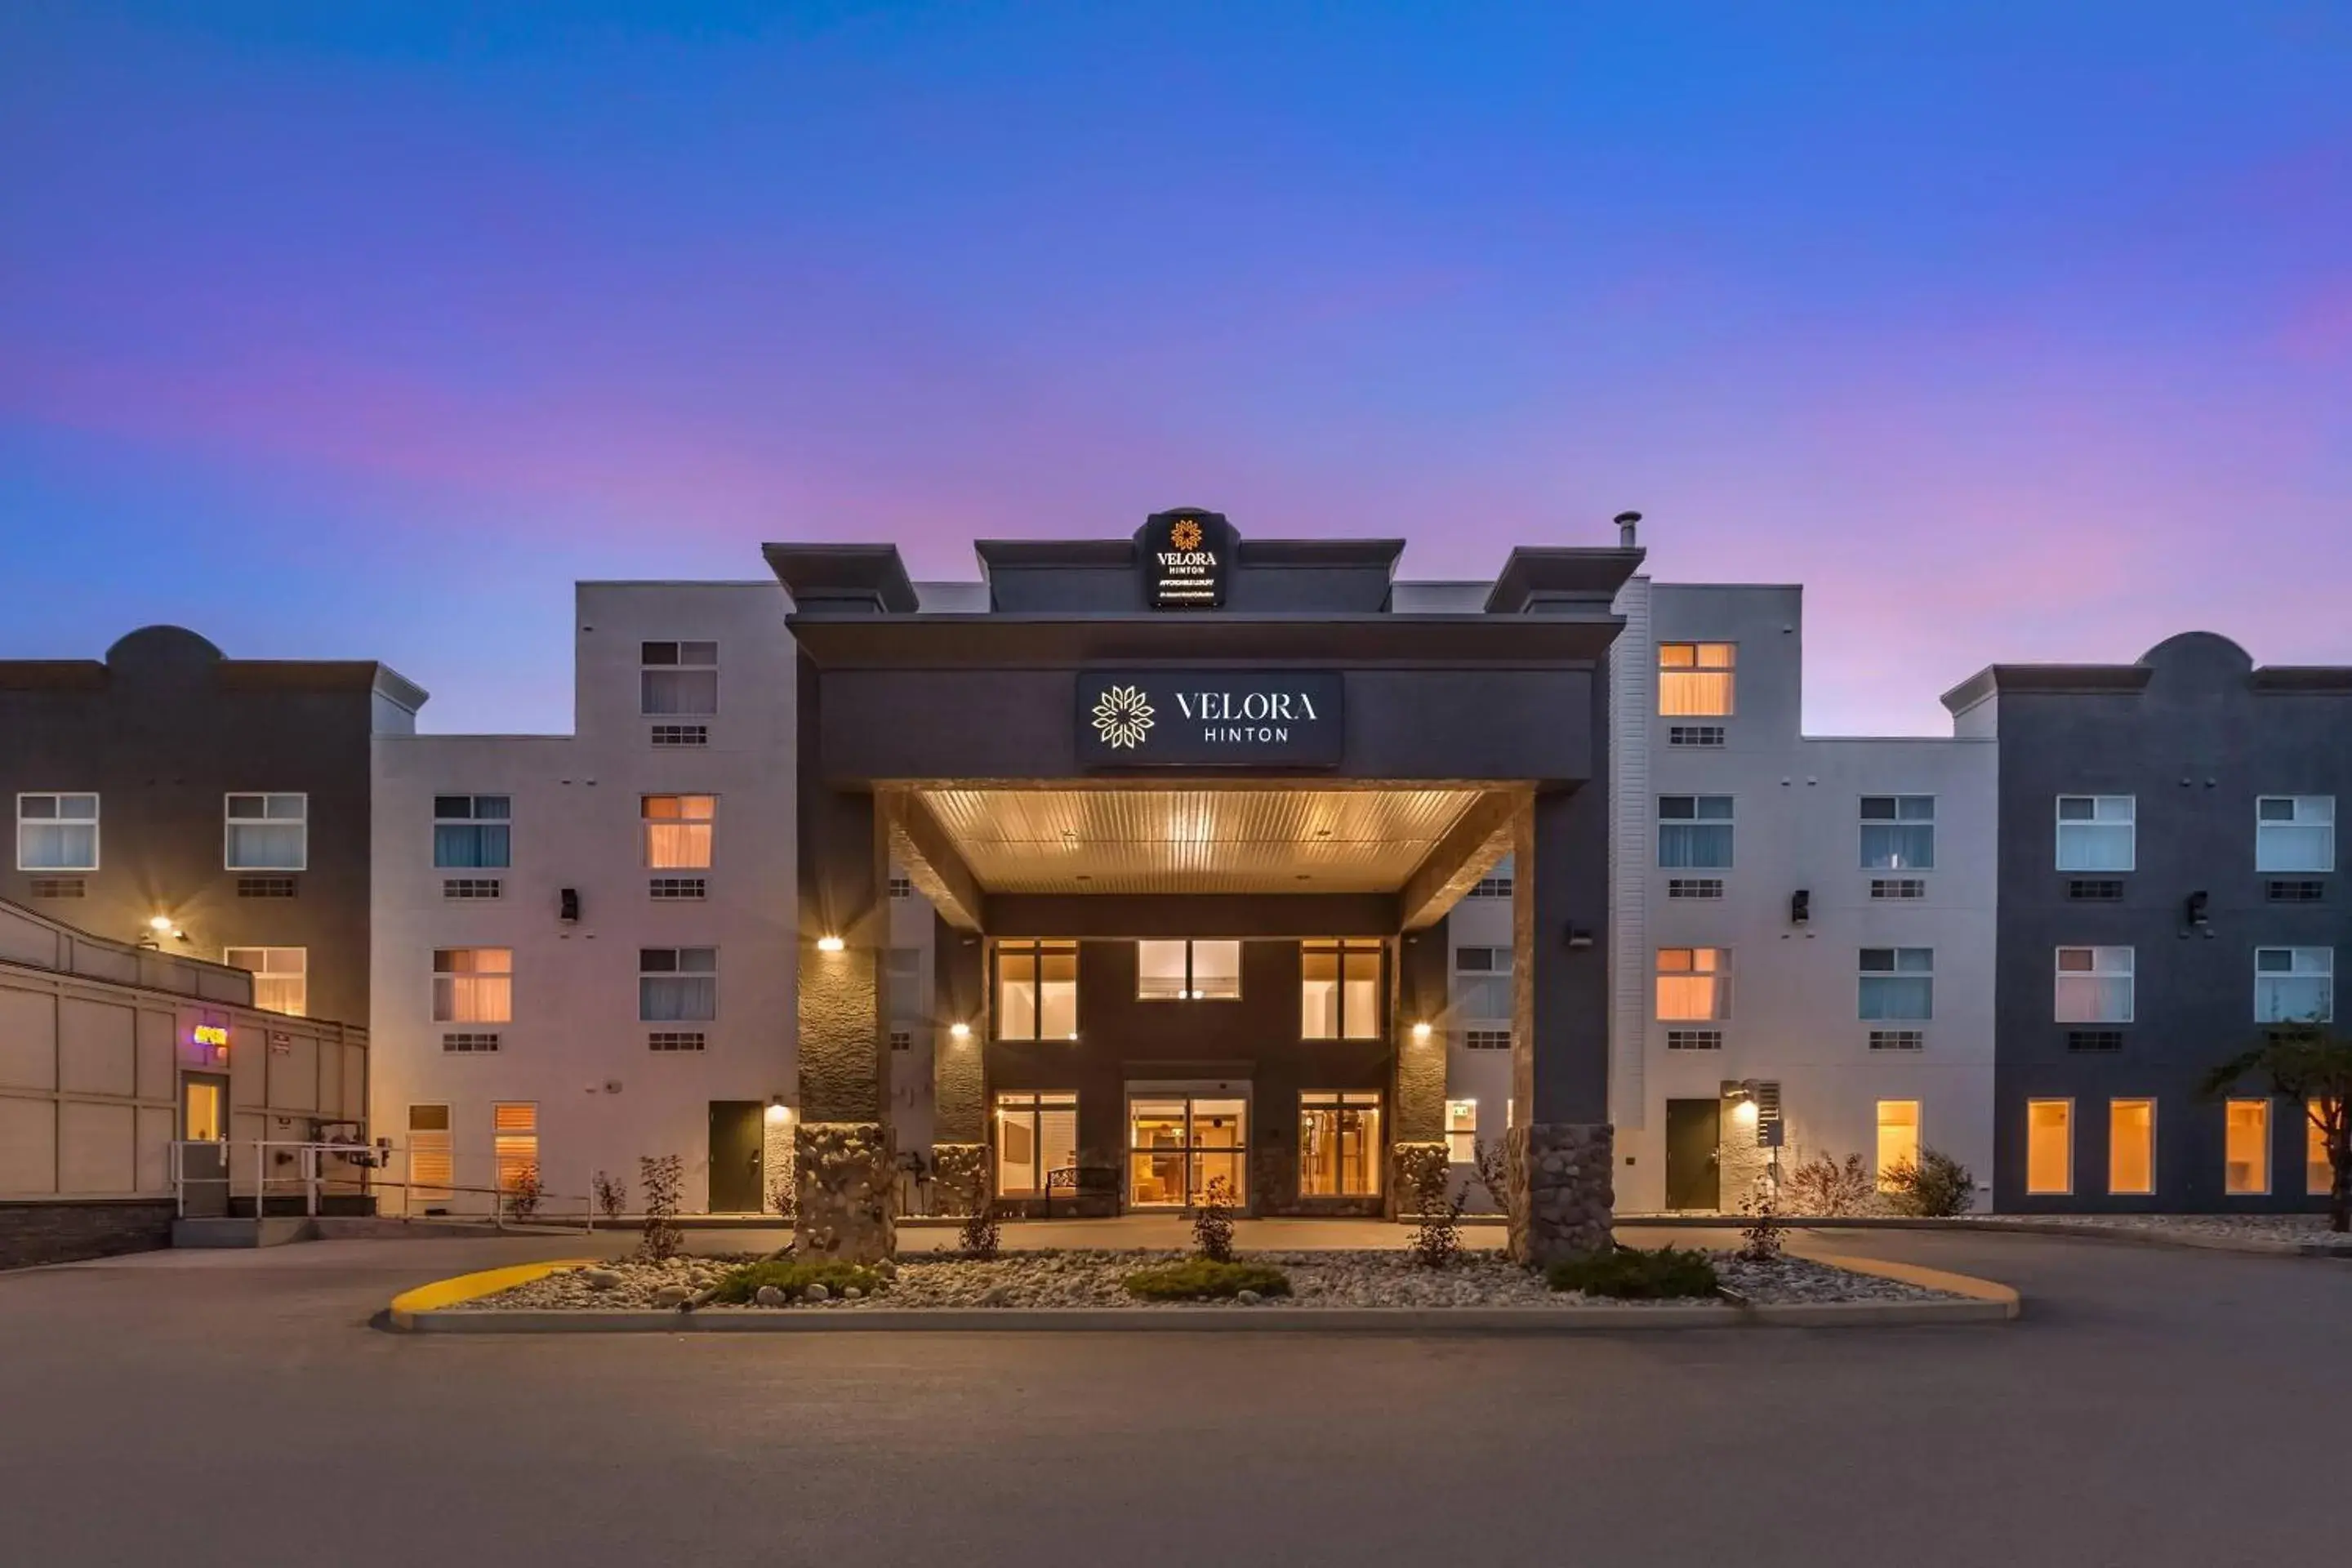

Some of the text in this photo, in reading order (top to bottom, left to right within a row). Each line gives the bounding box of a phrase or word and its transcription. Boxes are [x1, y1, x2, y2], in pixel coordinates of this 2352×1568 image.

[1156, 552, 1217, 565] VELORA
[1169, 566, 1205, 574] HINTON
[1174, 693, 1317, 719] VELORA
[1205, 728, 1288, 742] HINTON
